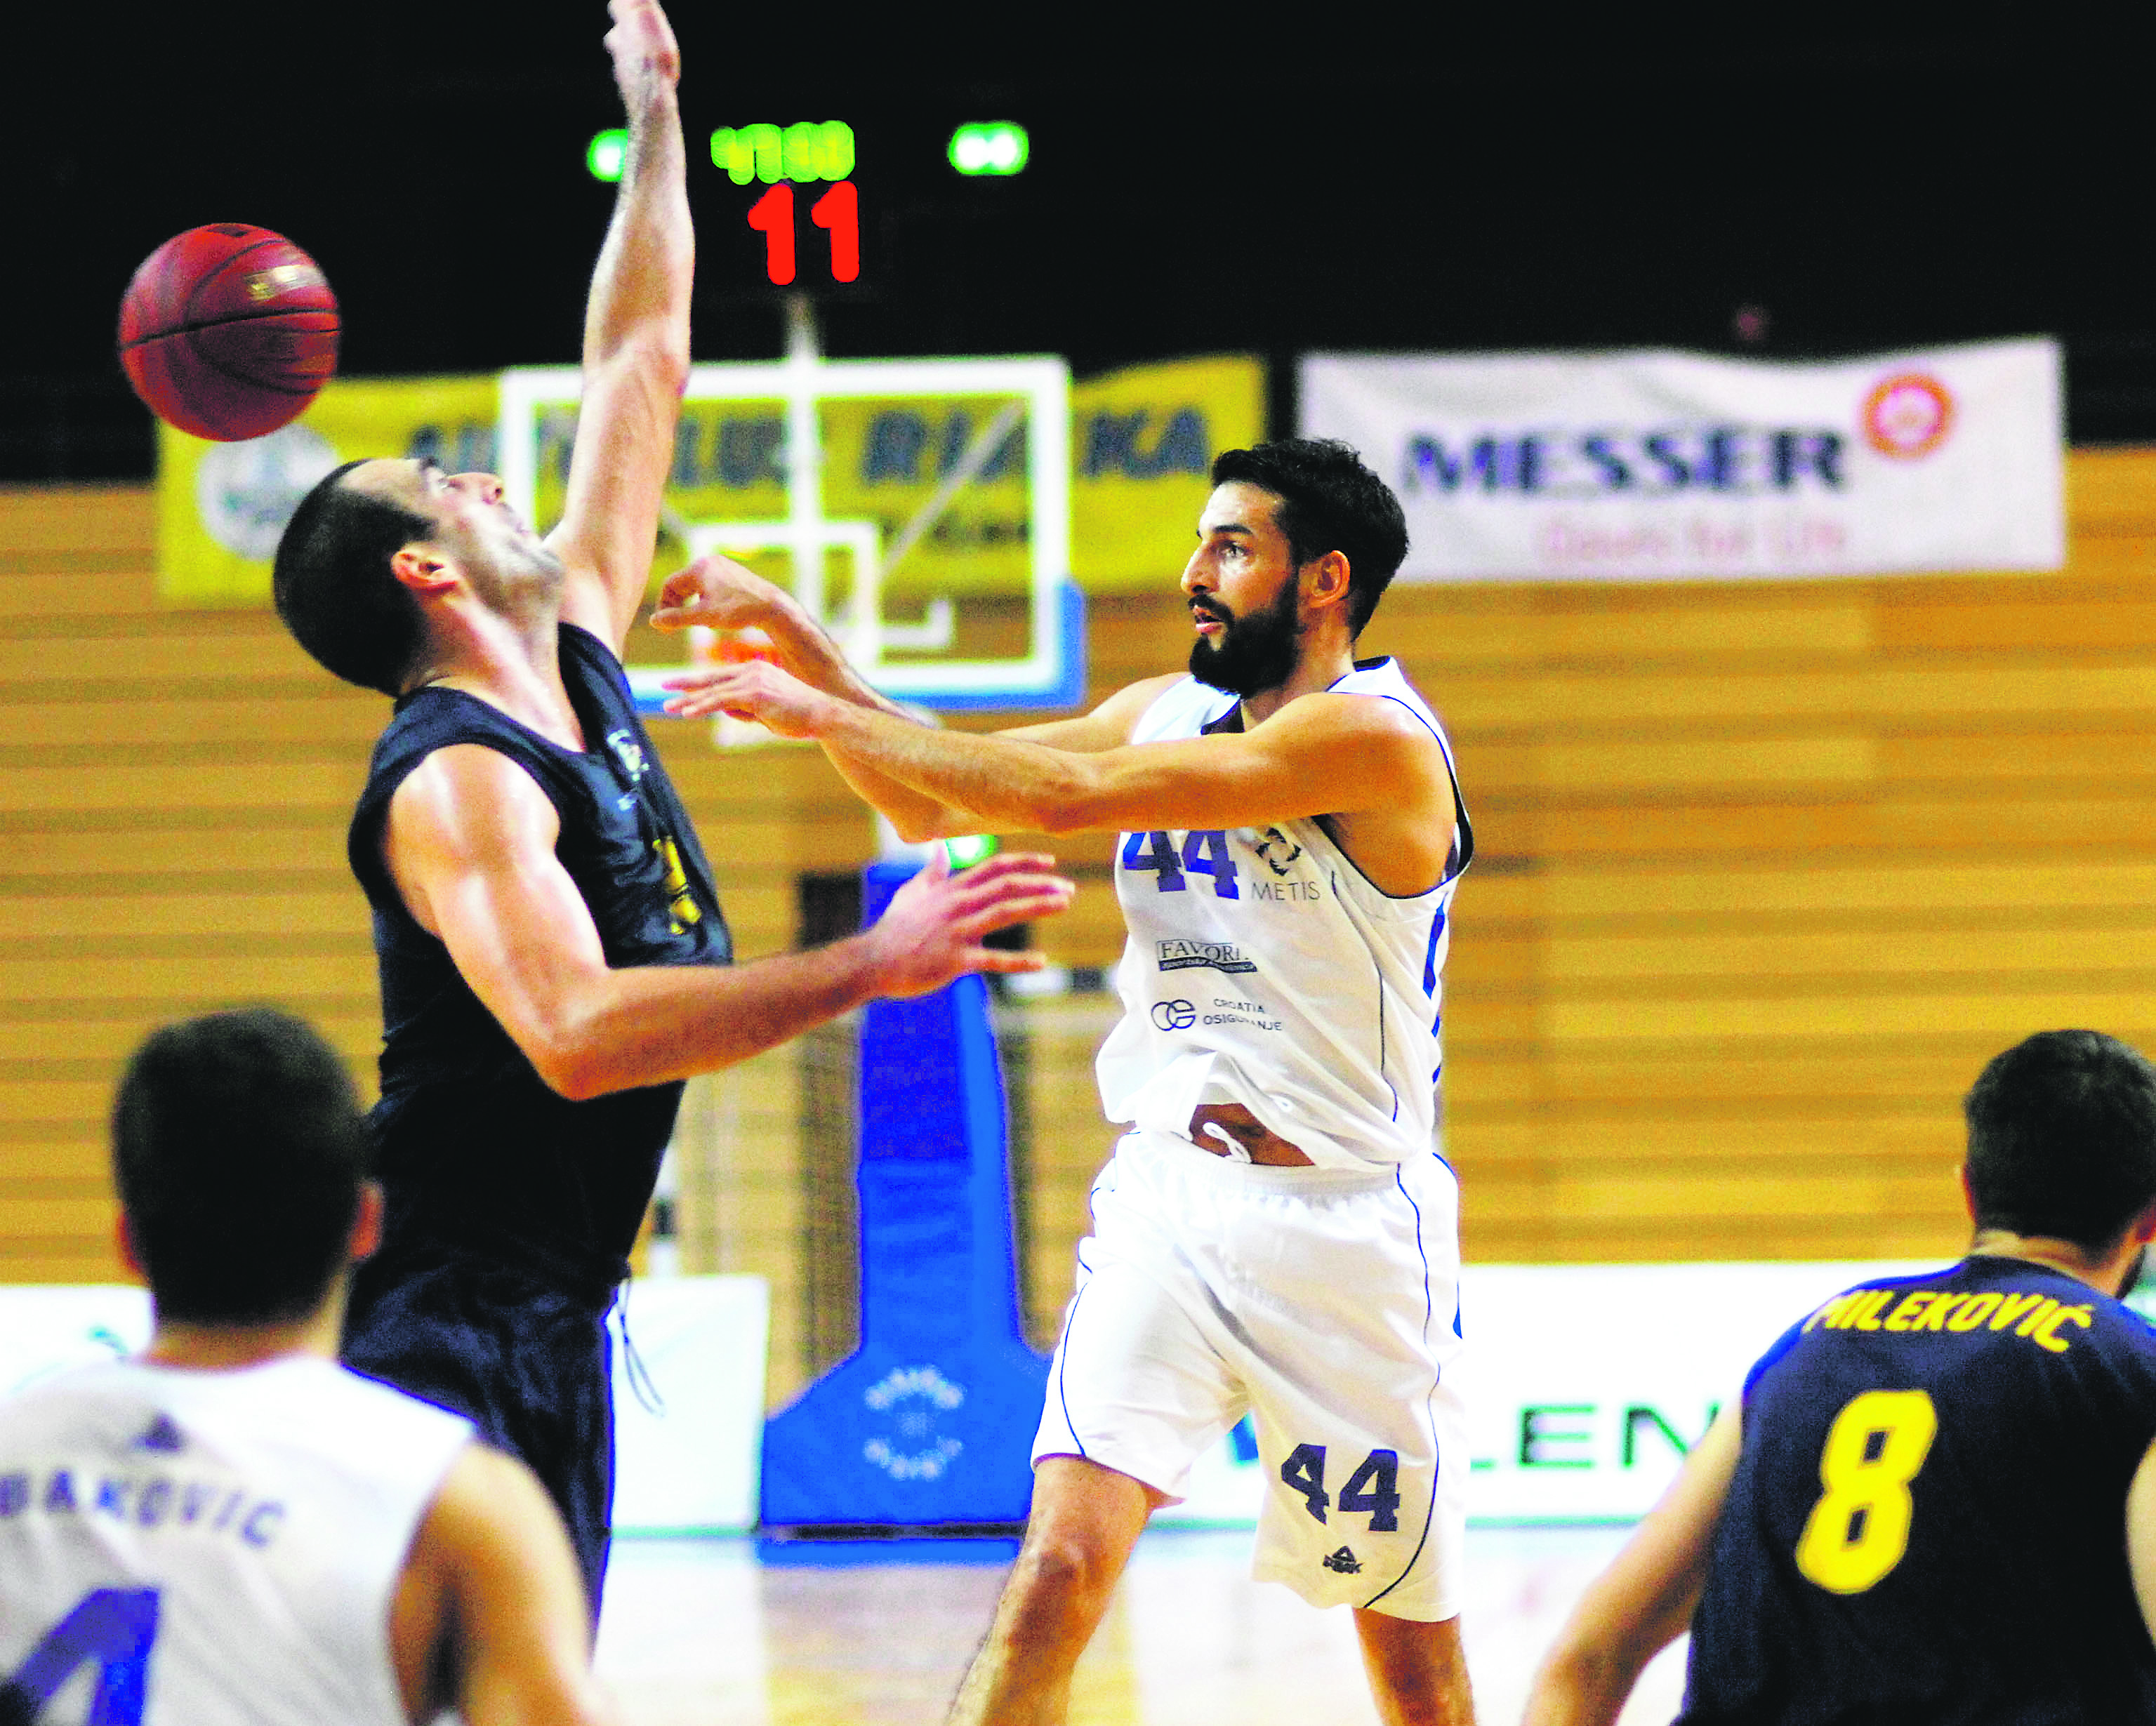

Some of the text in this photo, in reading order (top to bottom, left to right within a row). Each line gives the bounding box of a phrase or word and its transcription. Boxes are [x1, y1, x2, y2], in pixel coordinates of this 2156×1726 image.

[748, 183, 860, 286] 11
[1406, 427, 1849, 494] MESSER
[1123, 830, 1240, 900] 44
[1251, 880, 1321, 901] METIS
[1161, 941, 1250, 962] FAVORI
[1470, 1401, 1720, 1471] EN
[1281, 1442, 1401, 1532] 44
[1796, 1388, 1938, 1595] 8
